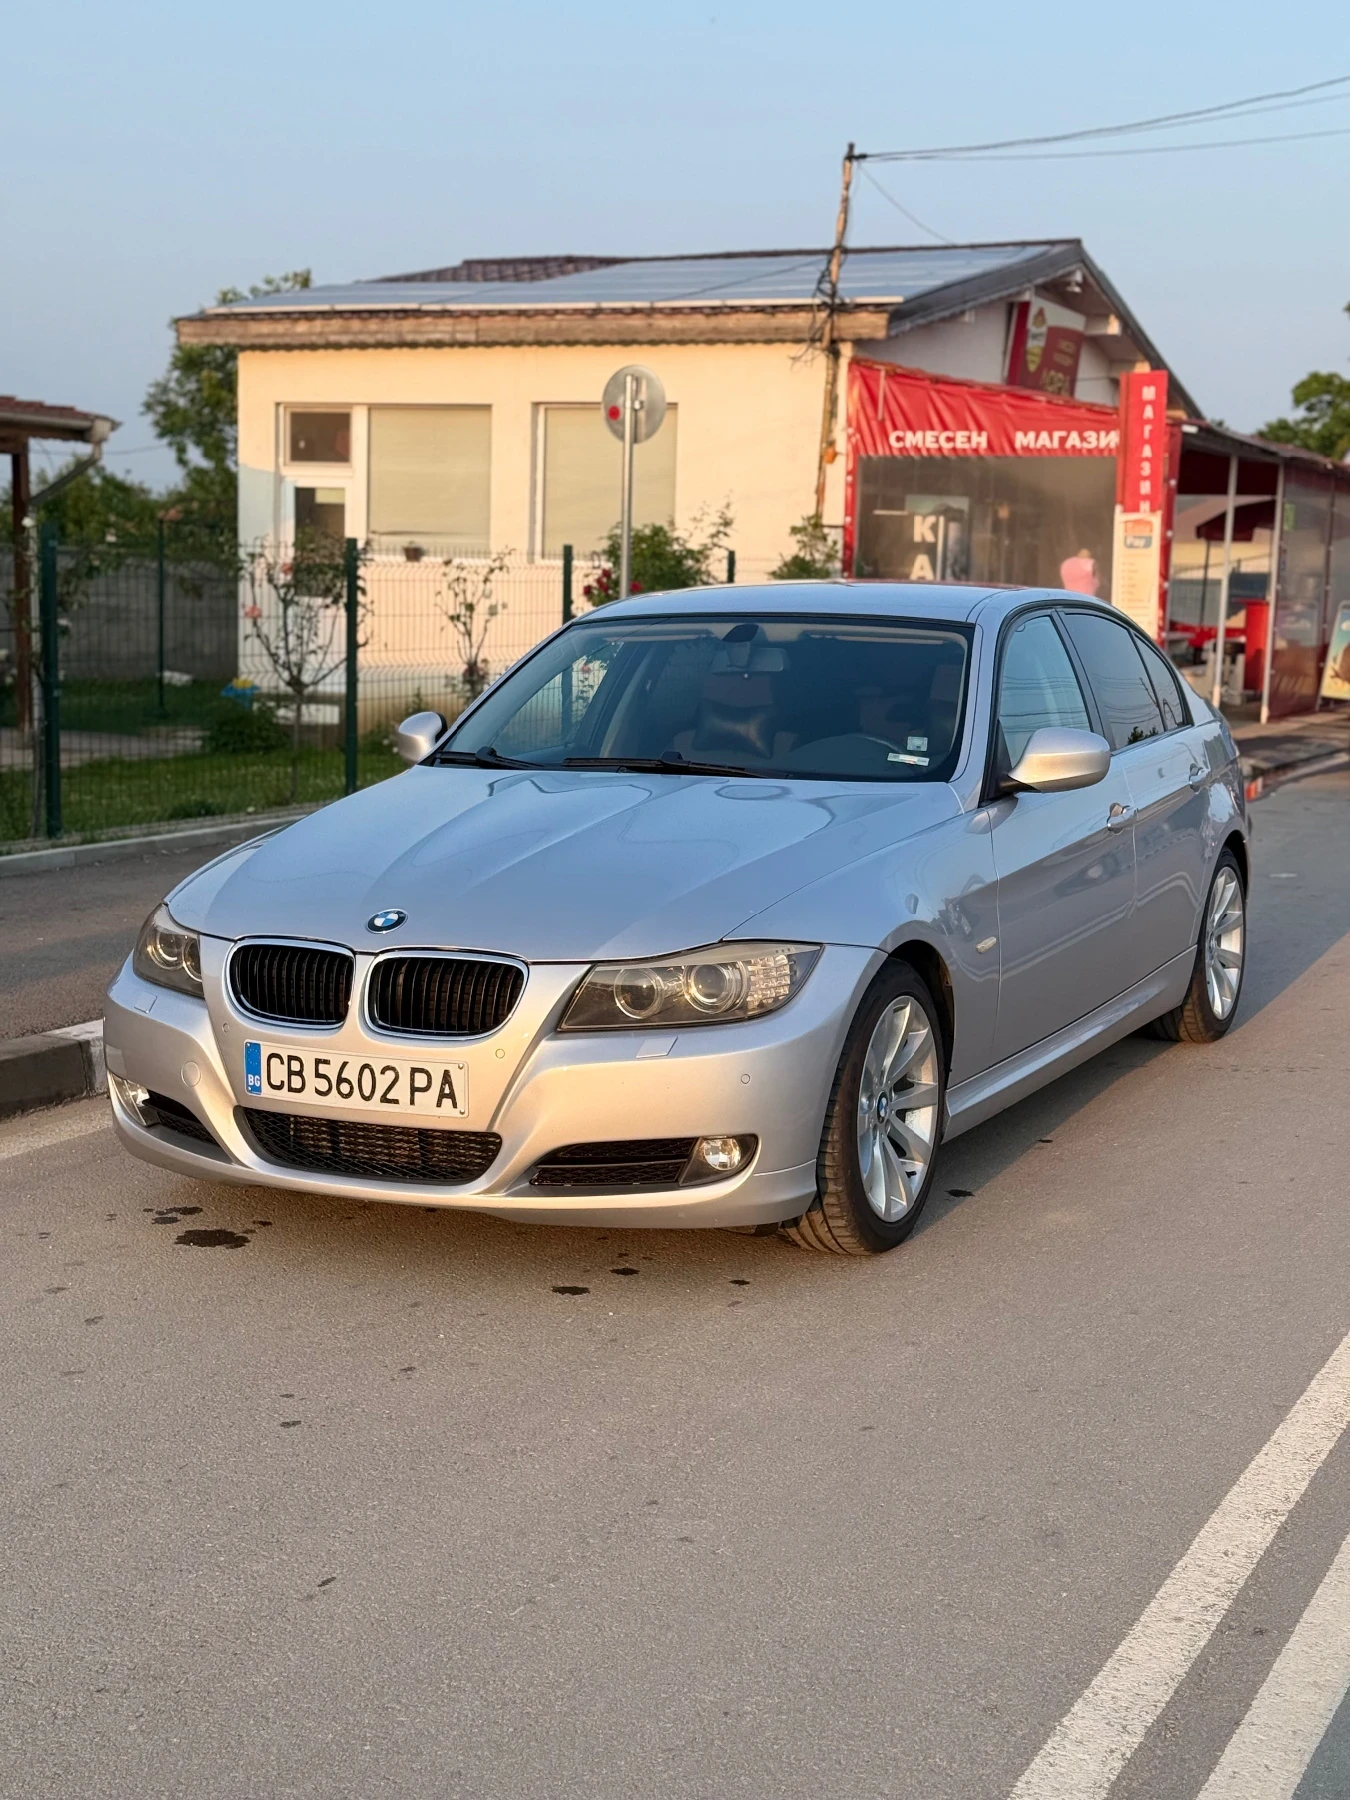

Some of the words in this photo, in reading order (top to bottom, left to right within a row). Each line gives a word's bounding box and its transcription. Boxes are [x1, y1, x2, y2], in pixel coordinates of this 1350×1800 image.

[889, 430, 988, 449] СМЕСЕН
[1014, 430, 1118, 449] МАГАЗИ
[247, 1073, 261, 1087] BG
